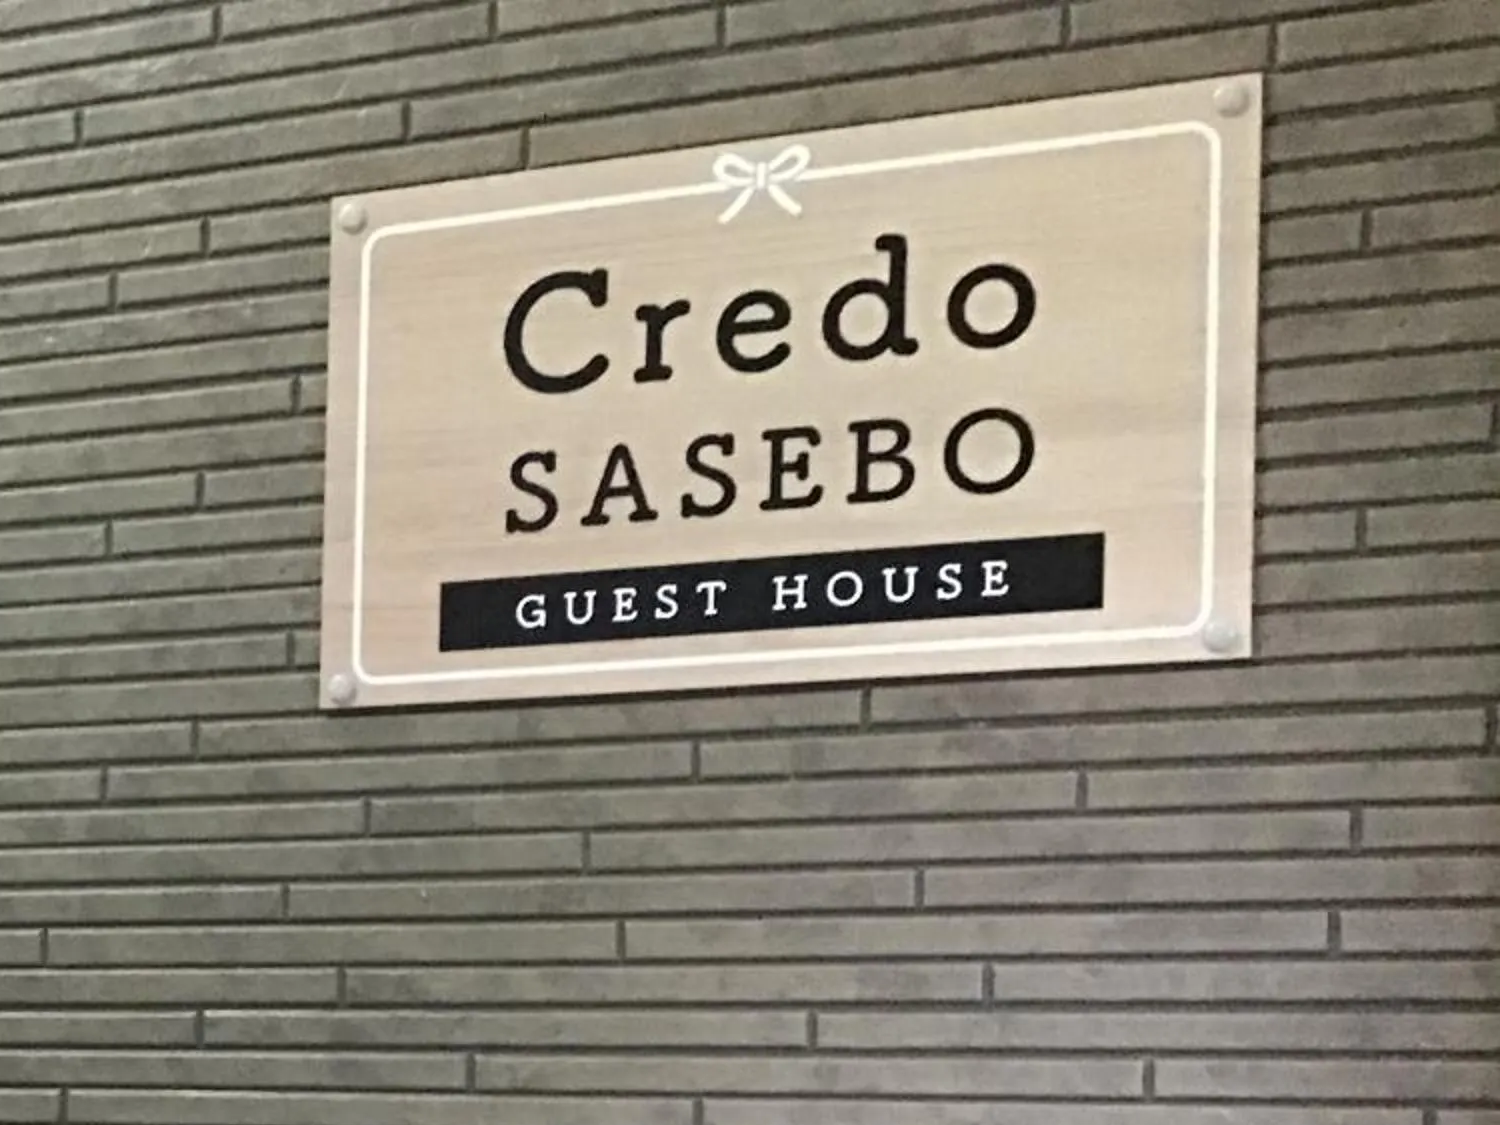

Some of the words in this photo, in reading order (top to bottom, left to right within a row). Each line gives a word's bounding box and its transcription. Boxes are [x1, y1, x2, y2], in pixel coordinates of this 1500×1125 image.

[503, 233, 1037, 394] Credo
[505, 408, 1035, 535] SASEBO
[515, 580, 728, 629] GUEST
[772, 560, 1011, 612] HOUSE
